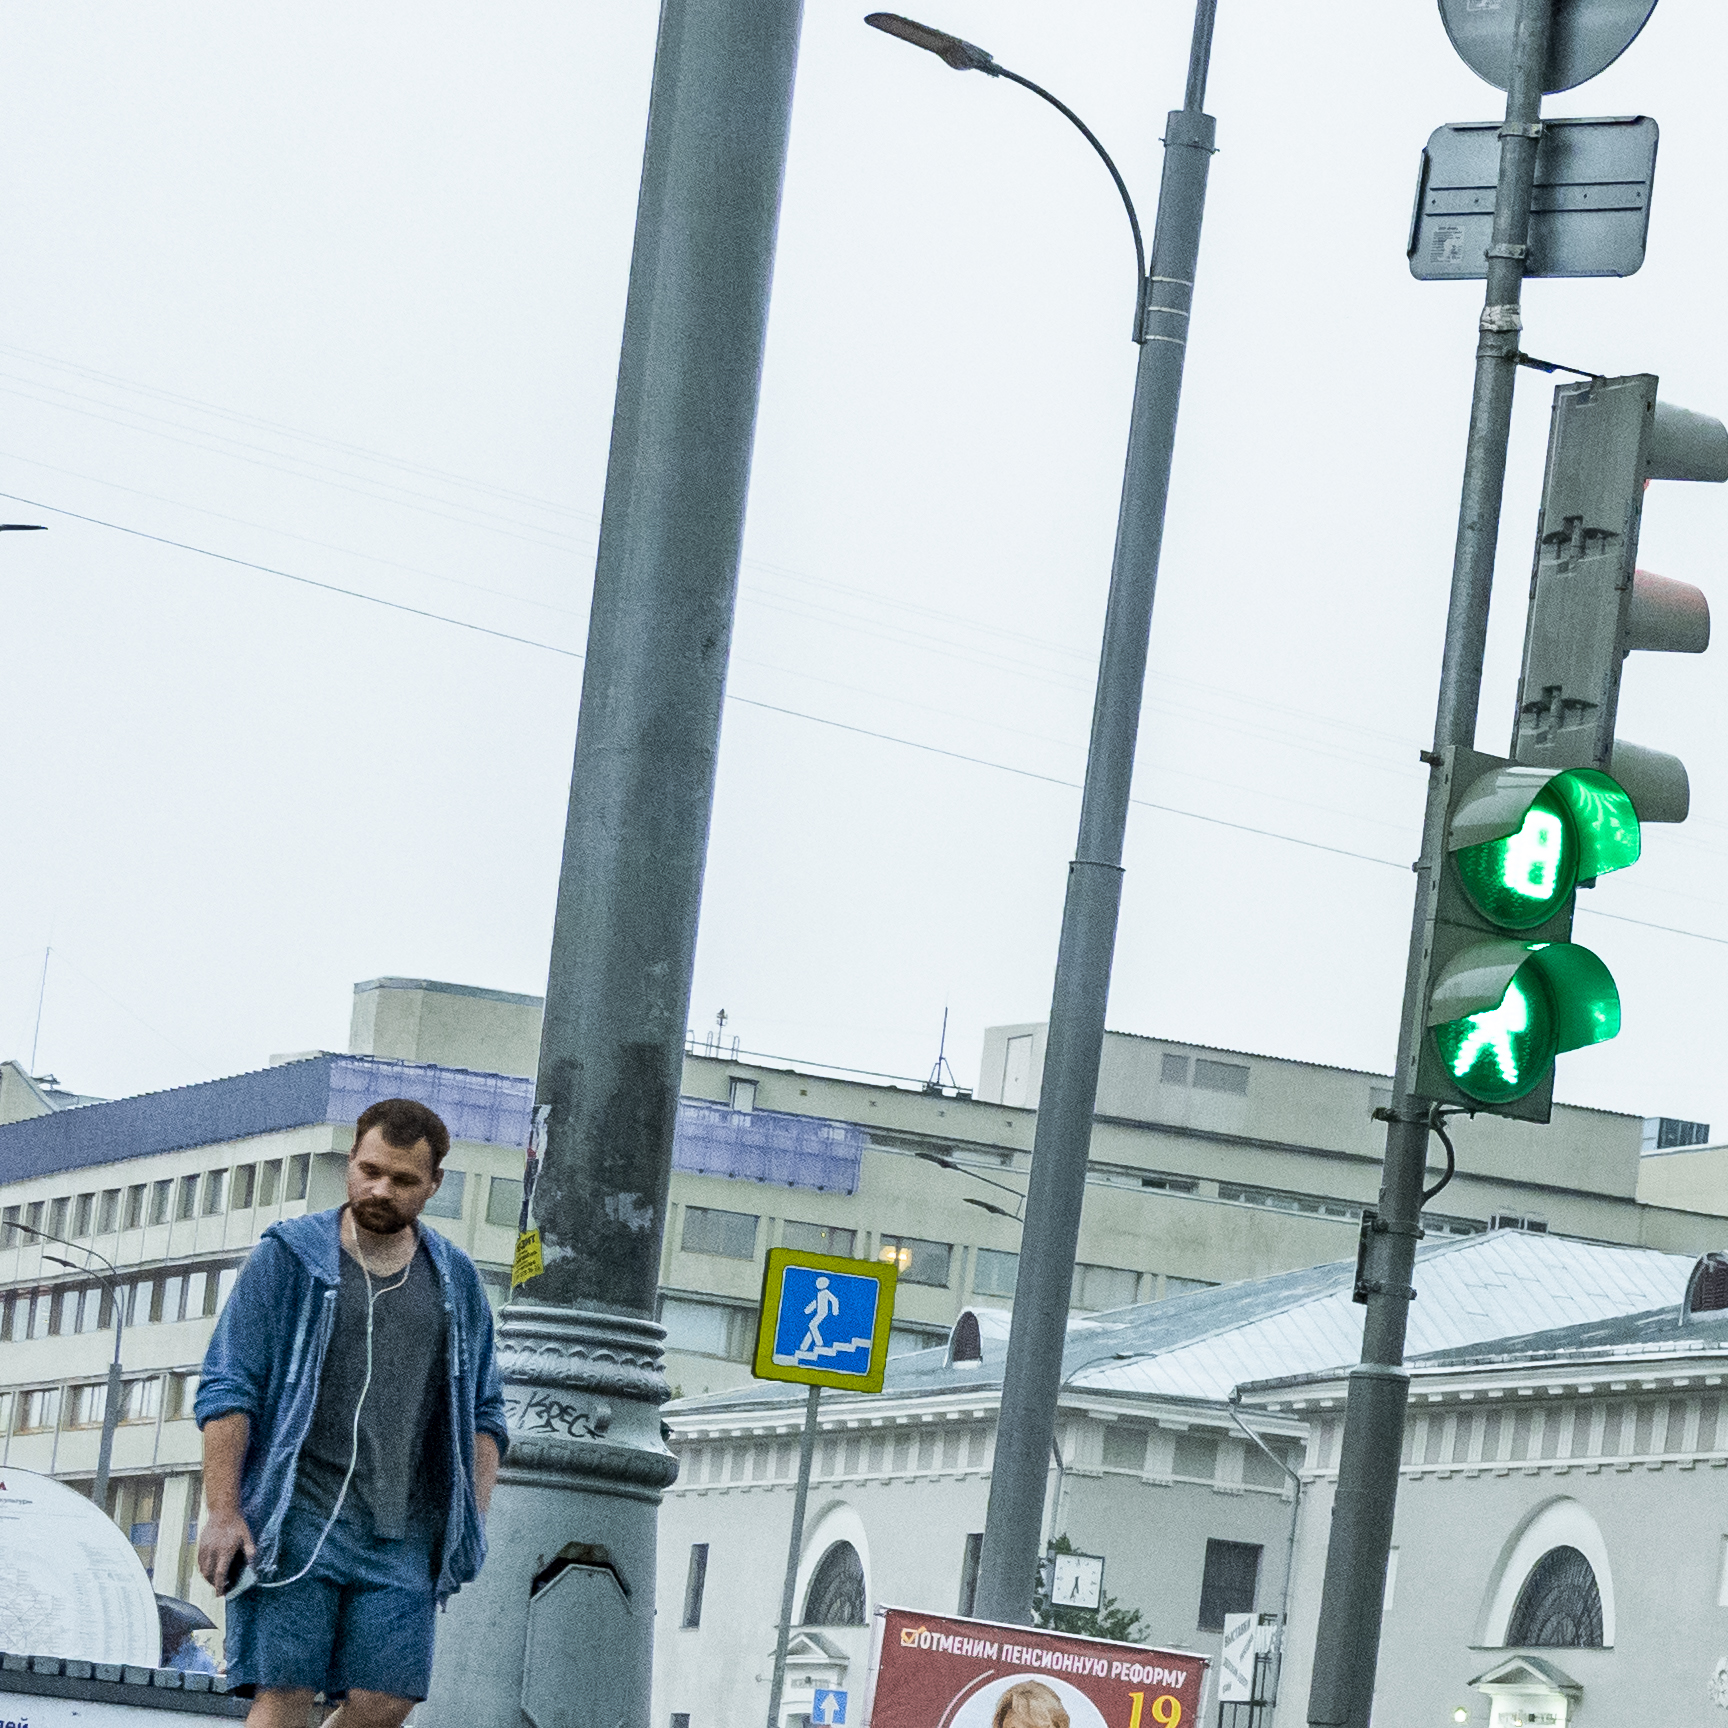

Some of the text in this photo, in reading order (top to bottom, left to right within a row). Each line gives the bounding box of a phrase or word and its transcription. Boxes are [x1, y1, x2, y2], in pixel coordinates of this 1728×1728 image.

[920, 1632, 1187, 1689] ОТМЕНИМ ПЕНСИОННУЮ РЕФОРМУ
